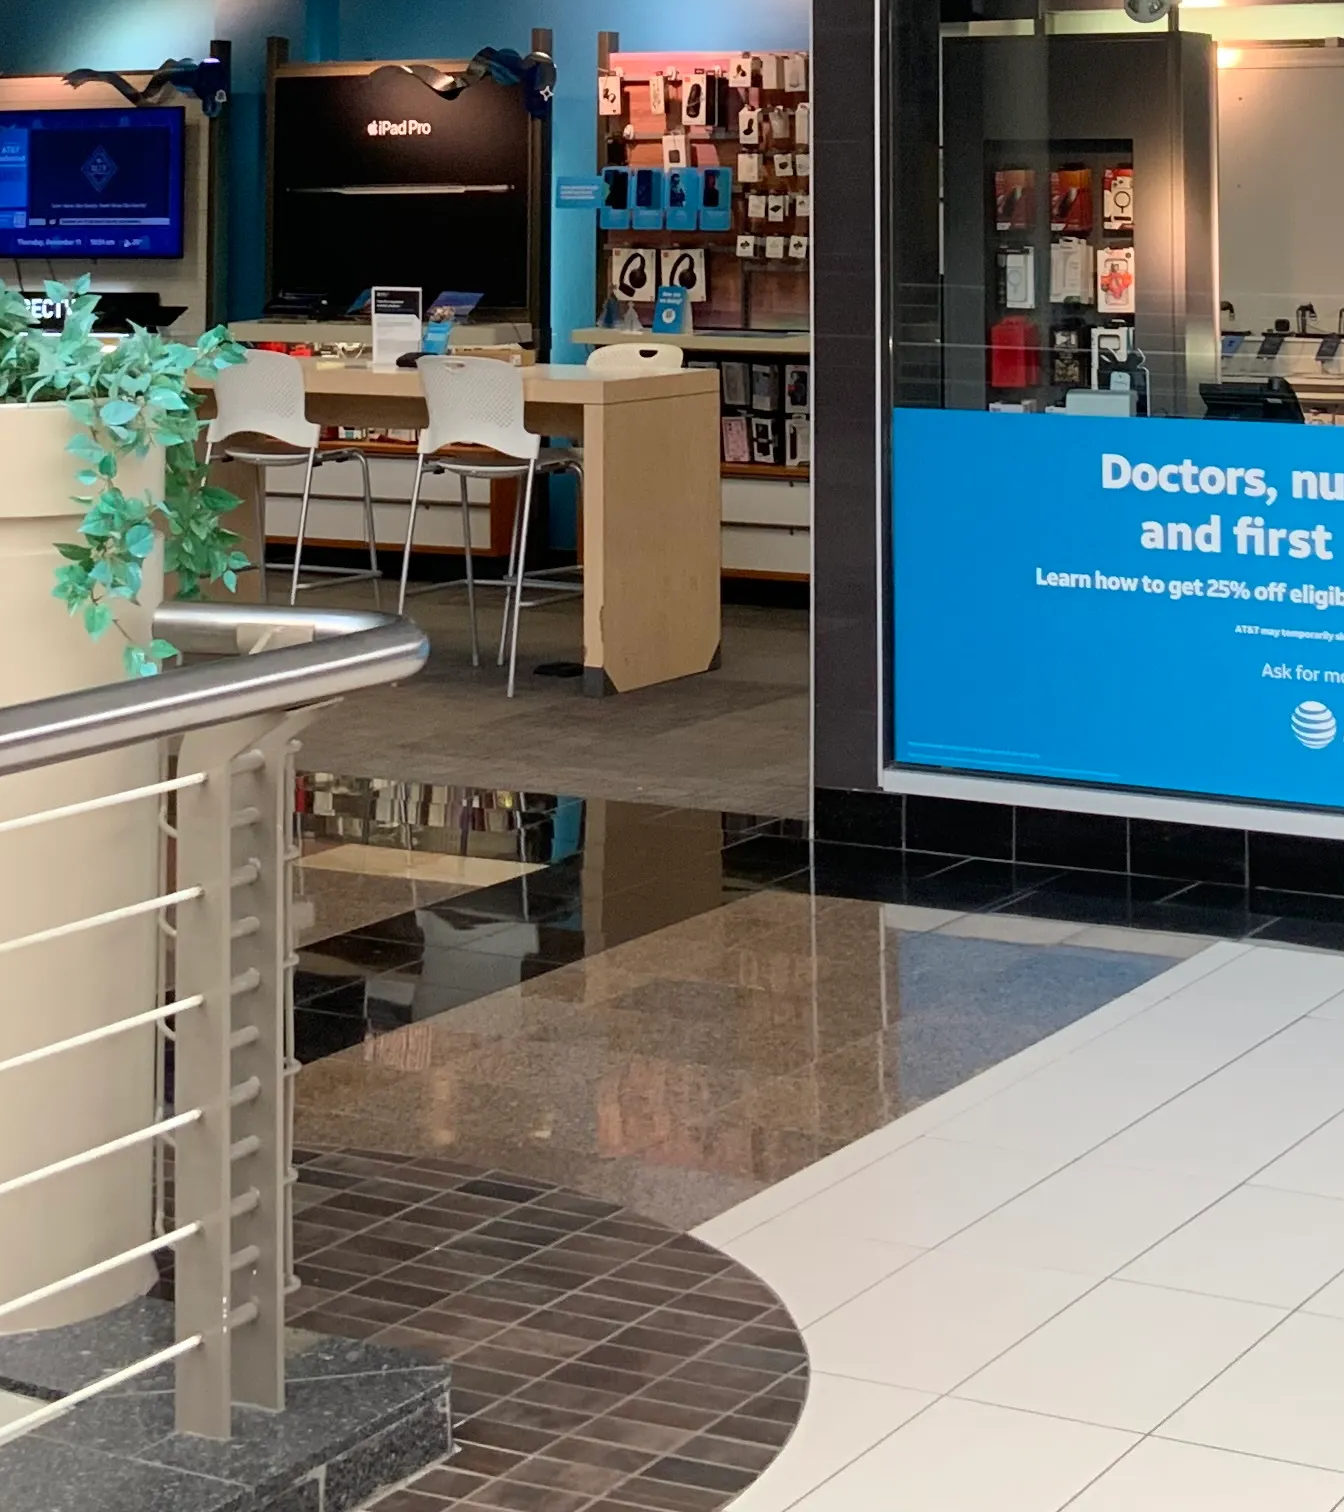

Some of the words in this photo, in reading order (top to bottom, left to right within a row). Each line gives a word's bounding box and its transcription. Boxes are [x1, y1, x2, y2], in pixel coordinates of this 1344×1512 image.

[378, 120, 407, 136] iPad
[408, 119, 432, 135] Pro
[1101, 453, 1279, 506] Doctors,
[1140, 514, 1222, 553] and
[1233, 516, 1334, 560] first
[1036, 567, 1092, 589] Learn
[1095, 570, 1139, 592] how
[1142, 575, 1165, 594] to
[1168, 579, 1204, 600] get
[1206, 579, 1251, 599] 25%
[1254, 582, 1287, 602] off
[1235, 624, 1260, 635] AT&T
[1261, 662, 1292, 679] Ask
[1296, 664, 1320, 682] for
